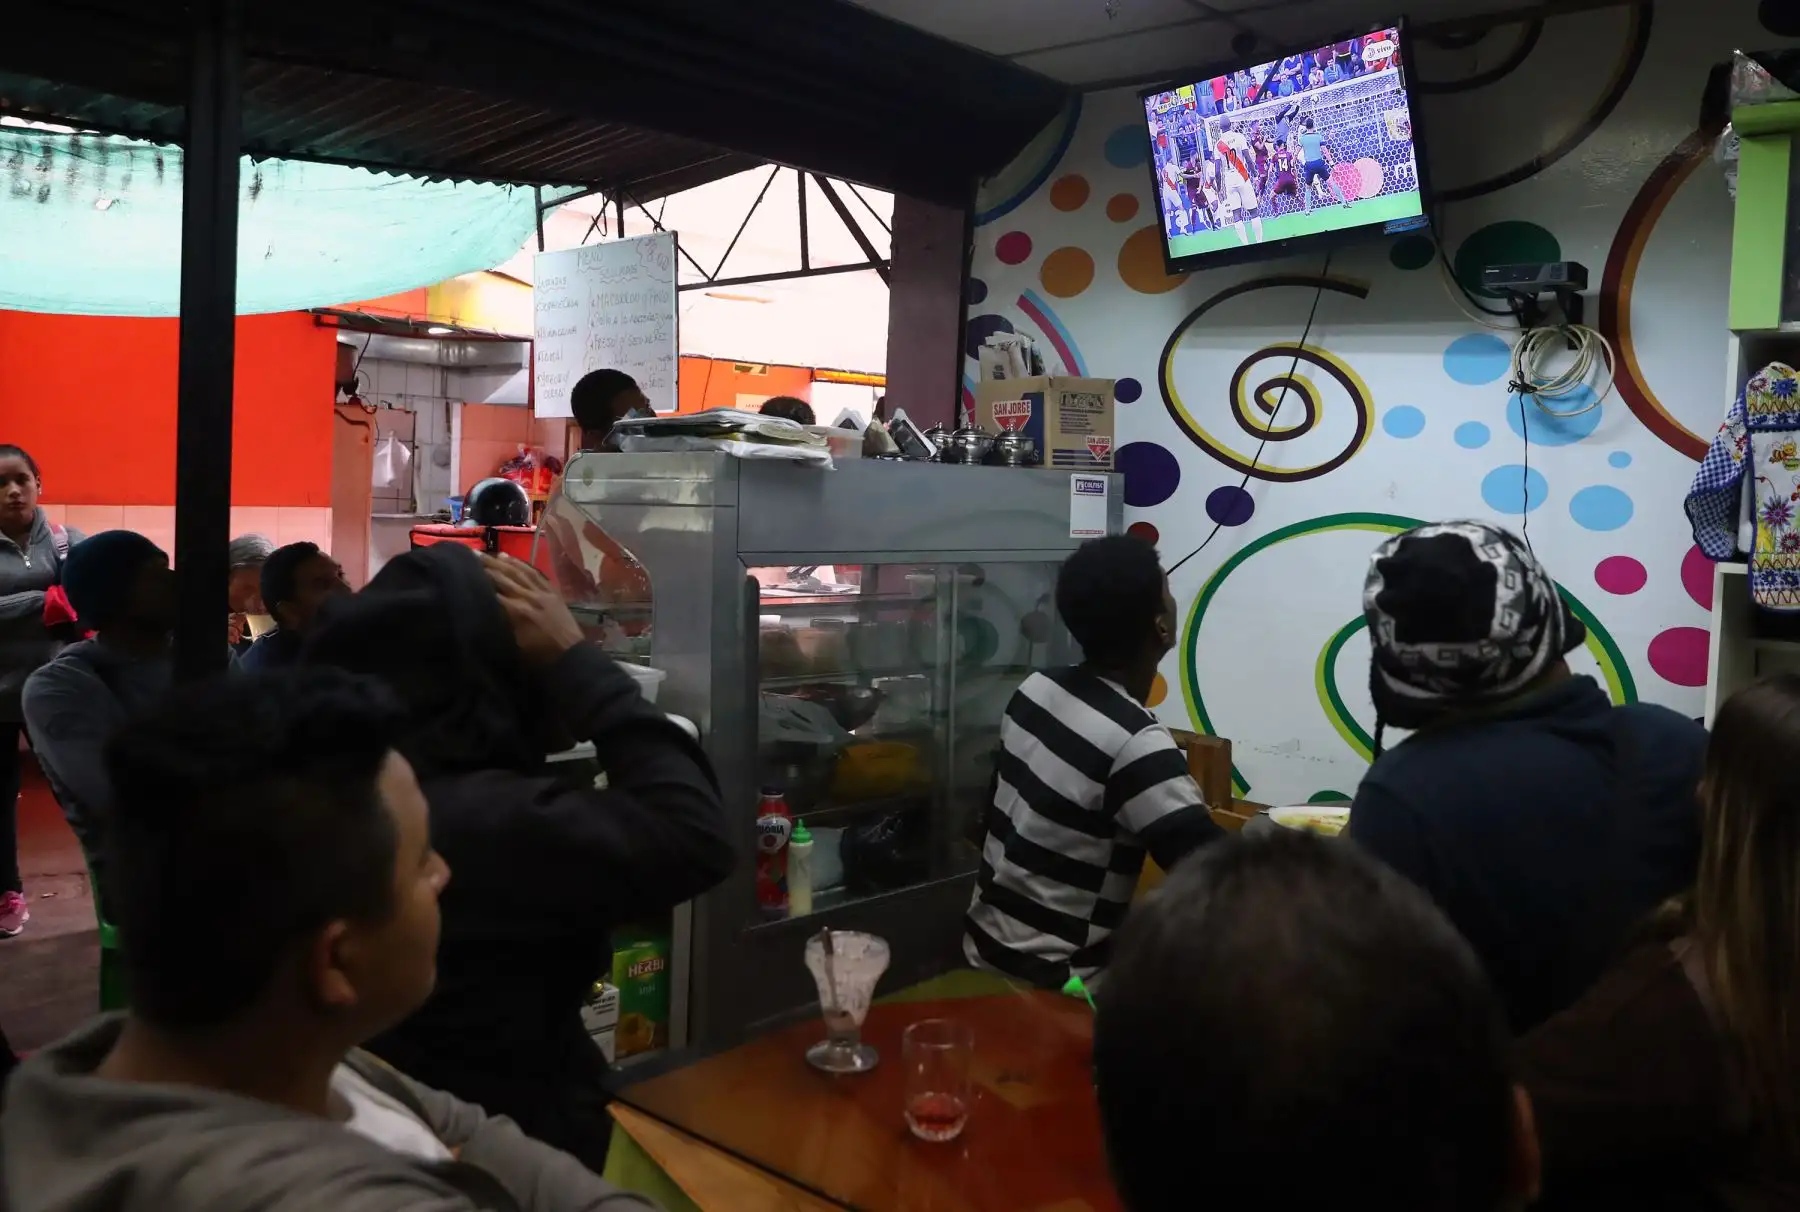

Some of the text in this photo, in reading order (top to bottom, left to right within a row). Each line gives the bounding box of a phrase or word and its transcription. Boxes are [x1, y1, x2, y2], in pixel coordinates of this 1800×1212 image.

[1278, 158, 1289, 172] 14
[993, 401, 1031, 416] SAN JORGE
